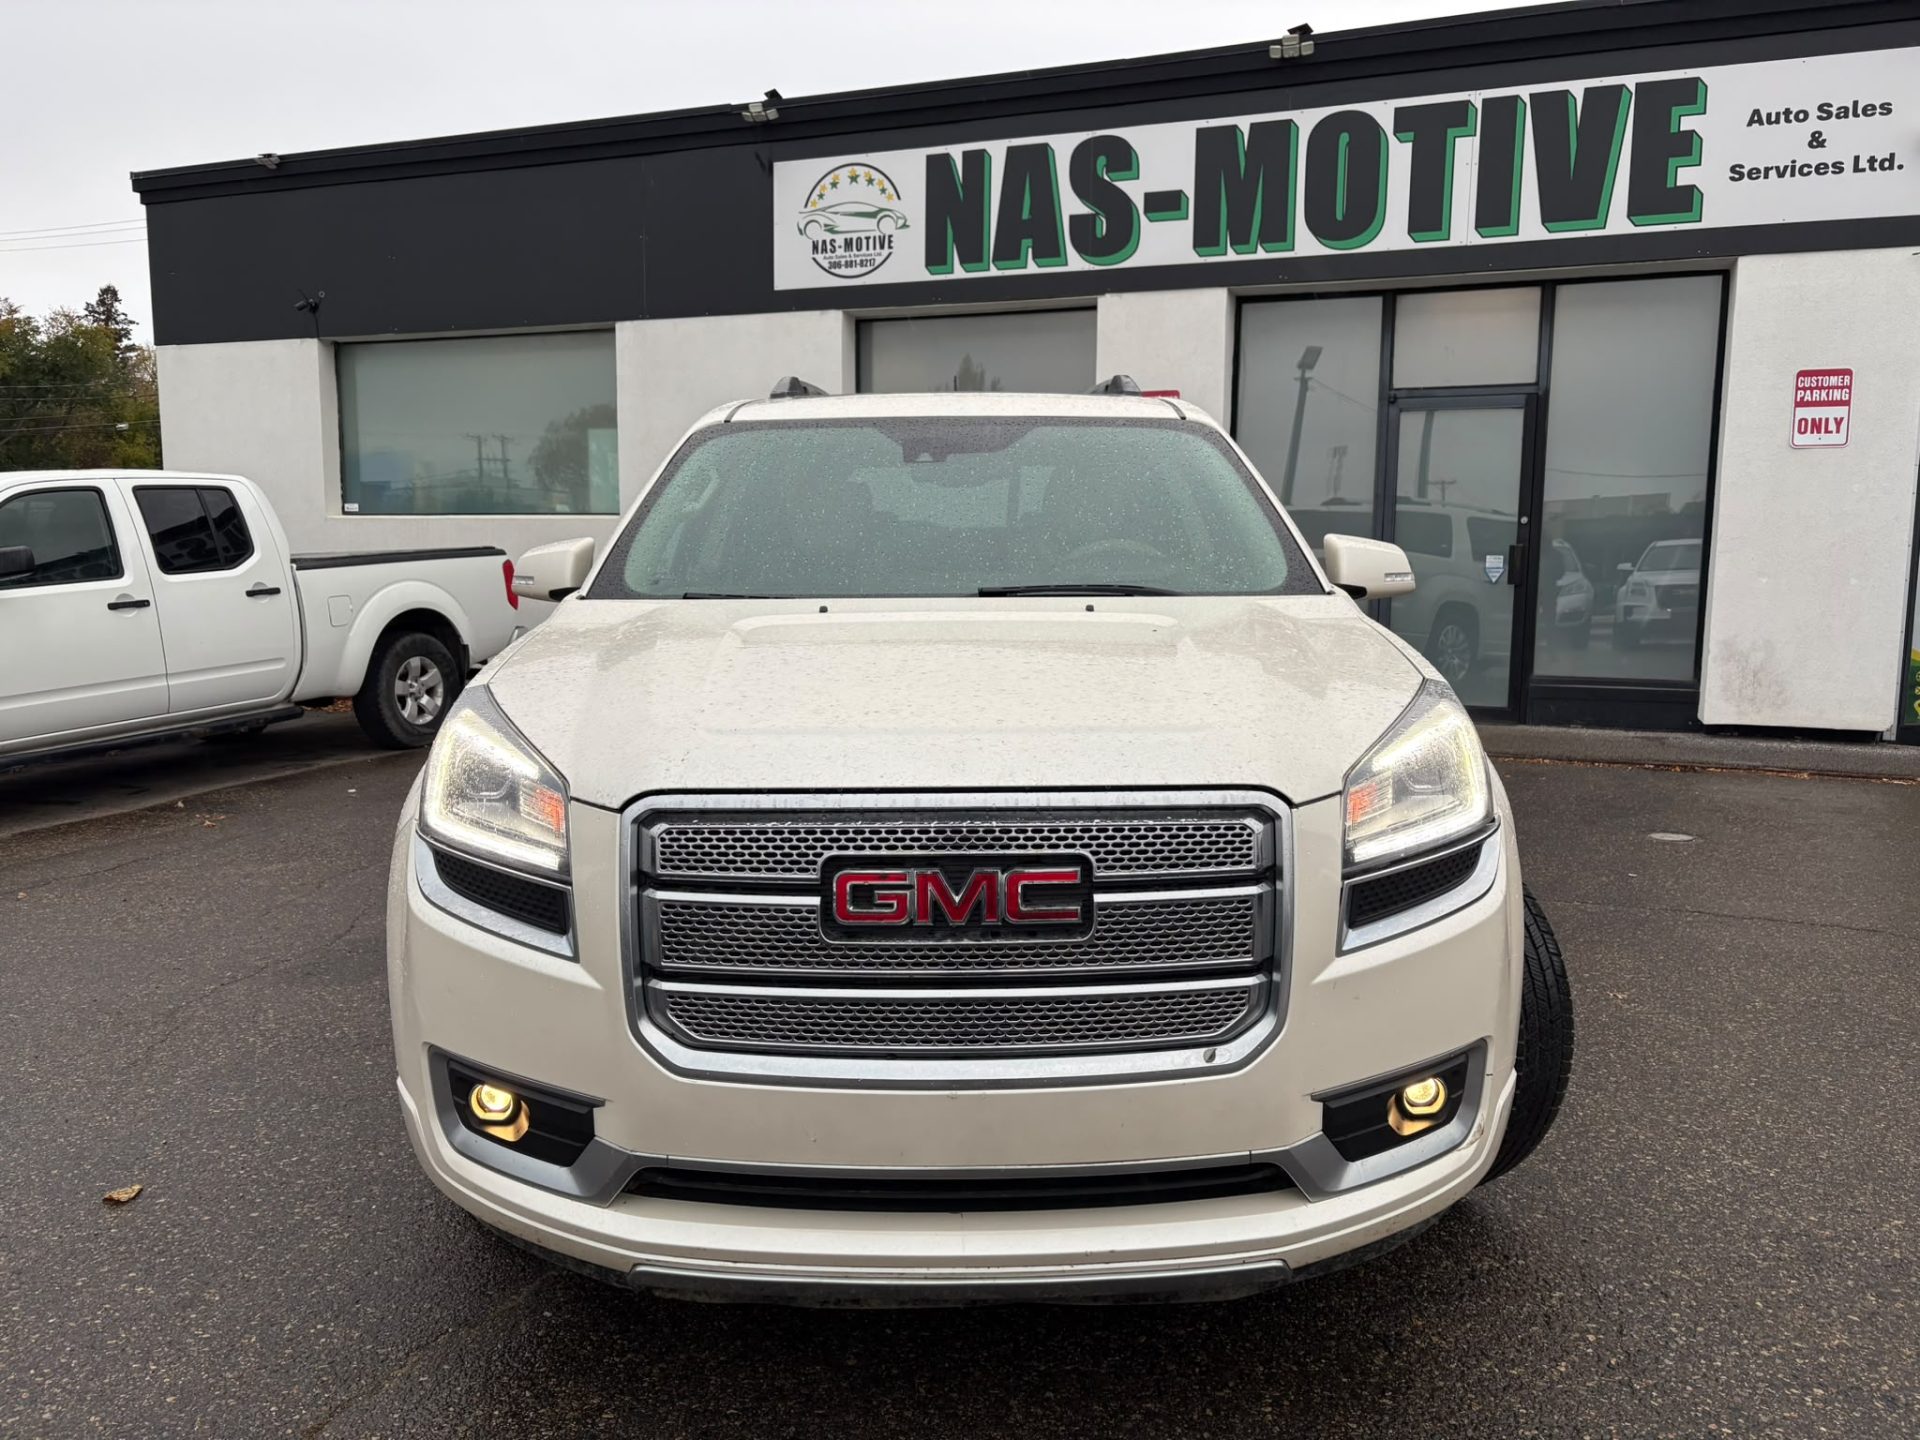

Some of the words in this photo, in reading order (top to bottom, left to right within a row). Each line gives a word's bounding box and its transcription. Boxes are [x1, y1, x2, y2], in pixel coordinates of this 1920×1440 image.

[1746, 107, 1810, 127] Auto
[1816, 99, 1893, 121] Sales
[1807, 130, 1827, 149] &
[925, 77, 1707, 276] NAS-MOTIVE
[1728, 159, 1845, 182] Services
[1852, 152, 1904, 173] Ltd.
[812, 234, 894, 255] NAS-MOTIVE
[1797, 375, 1850, 388] CUSTOMER
[1796, 388, 1850, 402] PARKING
[1797, 416, 1845, 435] ONLY
[833, 867, 1082, 926] GMC
